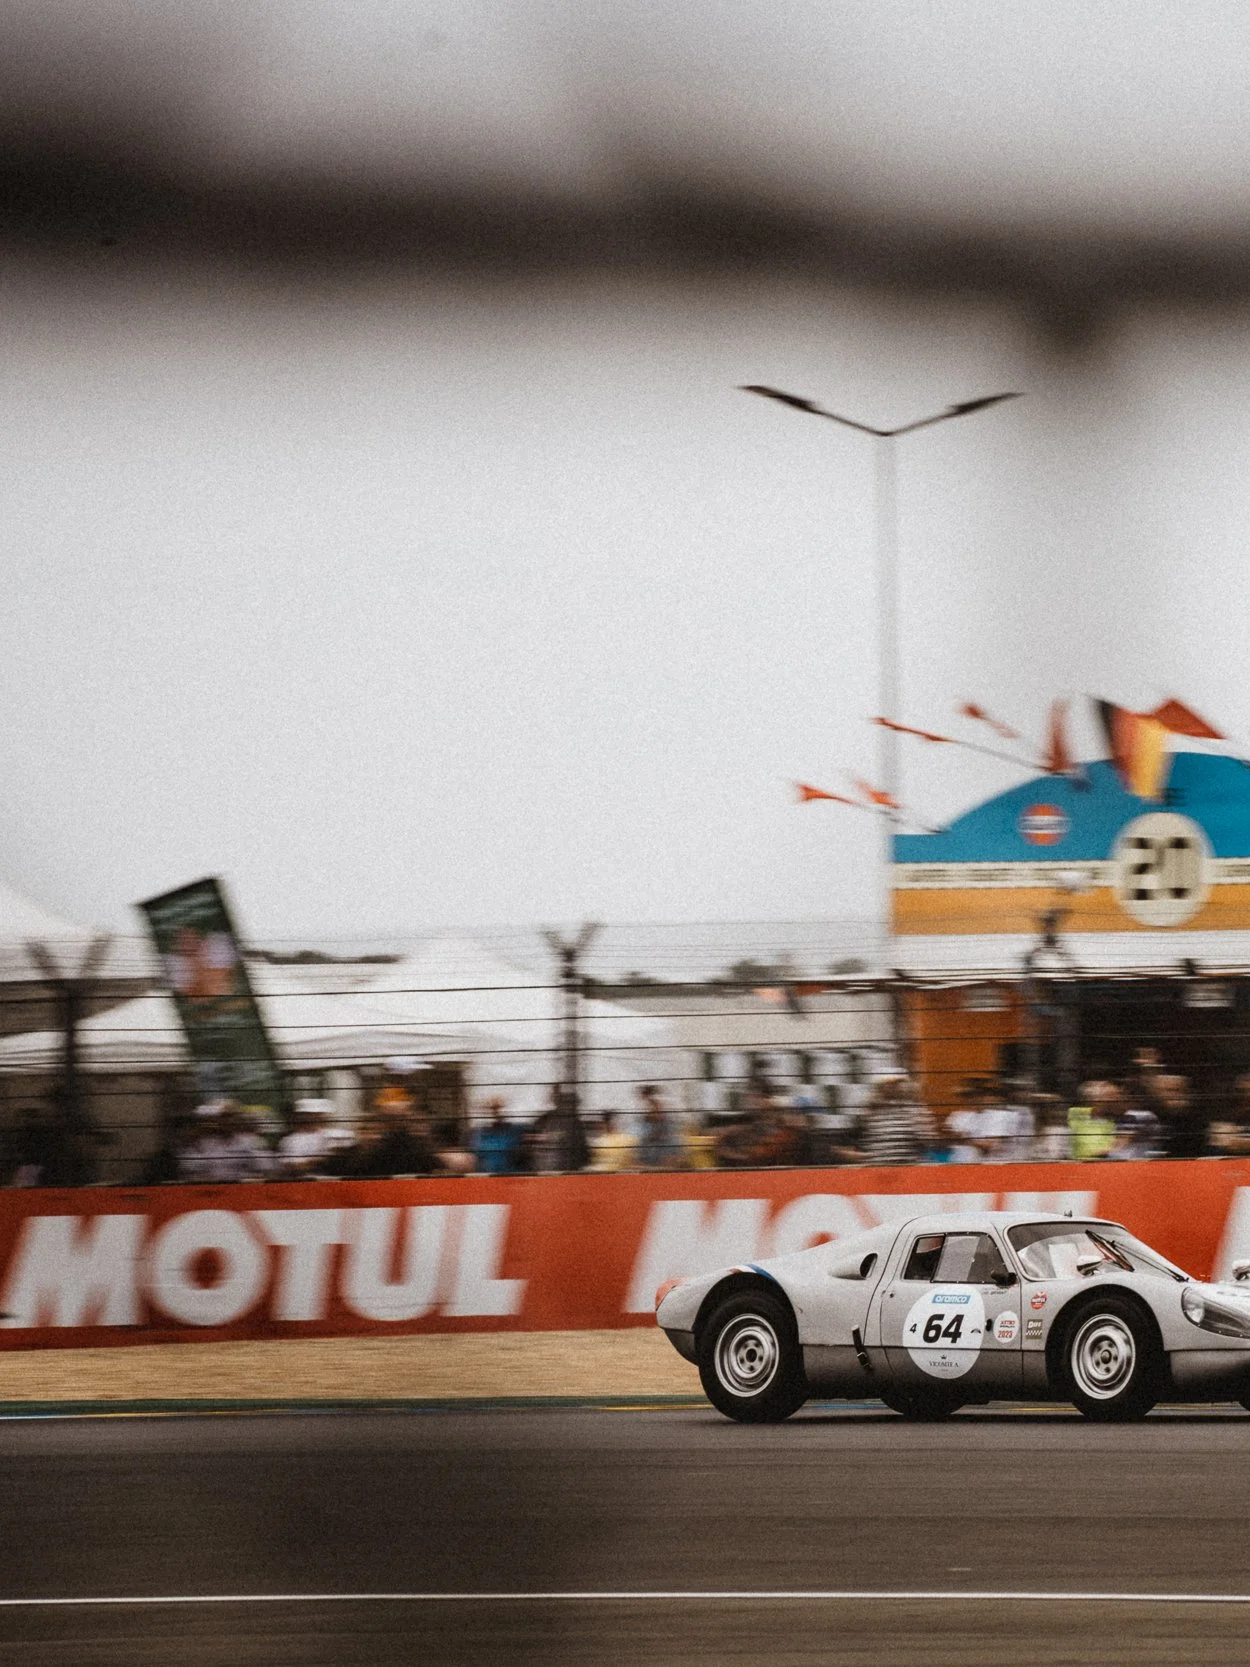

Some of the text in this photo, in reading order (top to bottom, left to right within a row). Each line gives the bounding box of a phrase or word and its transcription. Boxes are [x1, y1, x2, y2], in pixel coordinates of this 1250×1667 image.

[0, 1204, 528, 1328] MOTUL
[934, 1295, 968, 1303] aramco
[909, 1323, 917, 1333] 4
[922, 1313, 964, 1344] 64
